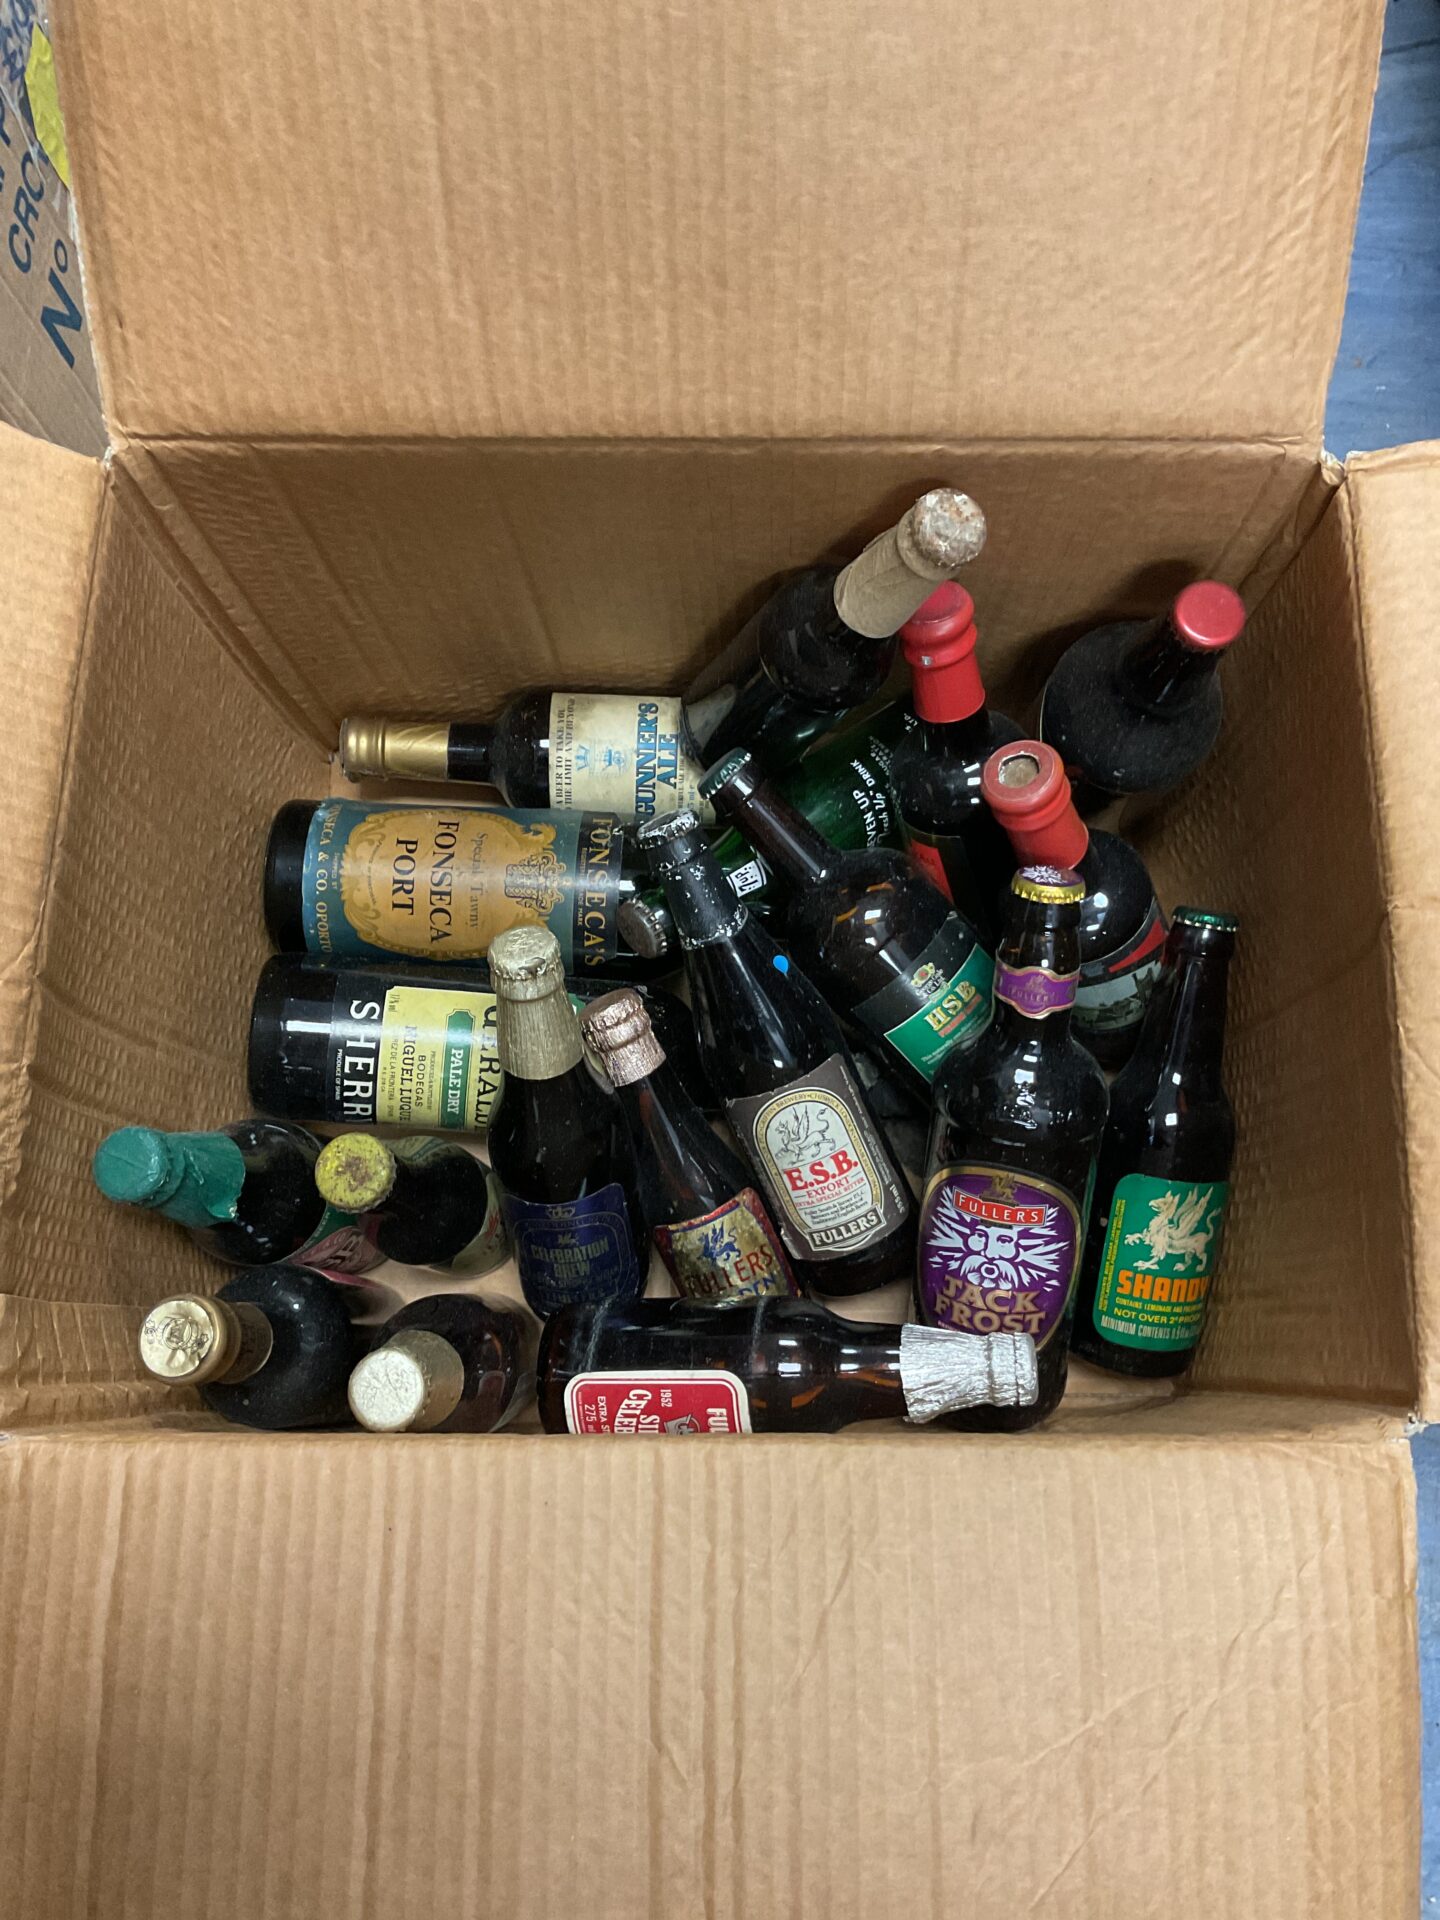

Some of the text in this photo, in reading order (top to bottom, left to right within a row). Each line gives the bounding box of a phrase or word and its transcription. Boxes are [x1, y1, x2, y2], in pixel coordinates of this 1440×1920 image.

[557, 709, 565, 724] YOU
[556, 726, 564, 754] TAKE
[565, 734, 573, 752] AND
[556, 755, 564, 770] TO
[564, 760, 572, 786] LIMIT
[635, 703, 659, 816] GUNNER'S
[656, 733, 680, 789] ALE
[850, 758, 876, 788] DRINK
[556, 773, 564, 798] BEER
[564, 791, 572, 805] THE
[317, 851, 329, 862] &
[470, 833, 489, 875] Special
[315, 868, 329, 895] CO.
[391, 837, 419, 916] PORT
[429, 820, 460, 943] FONSECA
[583, 817, 614, 967] FONSECA'S
[315, 901, 333, 953] OPORTO
[923, 980, 978, 1032] HSB
[335, 1048, 343, 1076] PRODUCE
[399, 1025, 417, 1121] MIGUEL LUQUE
[335, 1077, 341, 1085] OF
[415, 1055, 427, 1107] BODEGAS
[447, 1048, 464, 1115] PALE DRY
[784, 1149, 859, 1191] E.S.B.
[794, 1200, 816, 1208] EXTRA
[816, 1191, 842, 1206] SPECIAL
[844, 1176, 865, 1192] BITTER
[806, 1175, 850, 1199] EXPORT
[812, 1211, 878, 1245] FULLERS
[530, 1236, 610, 1263] CELEBRATION
[554, 1260, 590, 1279] BREW
[943, 1274, 1041, 1314] JACK
[1116, 1296, 1143, 1310] CONTAINS
[933, 1294, 1047, 1336] FROST
[1100, 1314, 1137, 1336] MINIMUM
[1137, 1324, 1171, 1340] CONTENTS
[1113, 1307, 1137, 1320] NOT
[1139, 1312, 1167, 1324] OVER
[597, 1395, 607, 1423] EXTRA
[660, 1389, 672, 1408] 1952
[584, 1404, 597, 1422] 275
